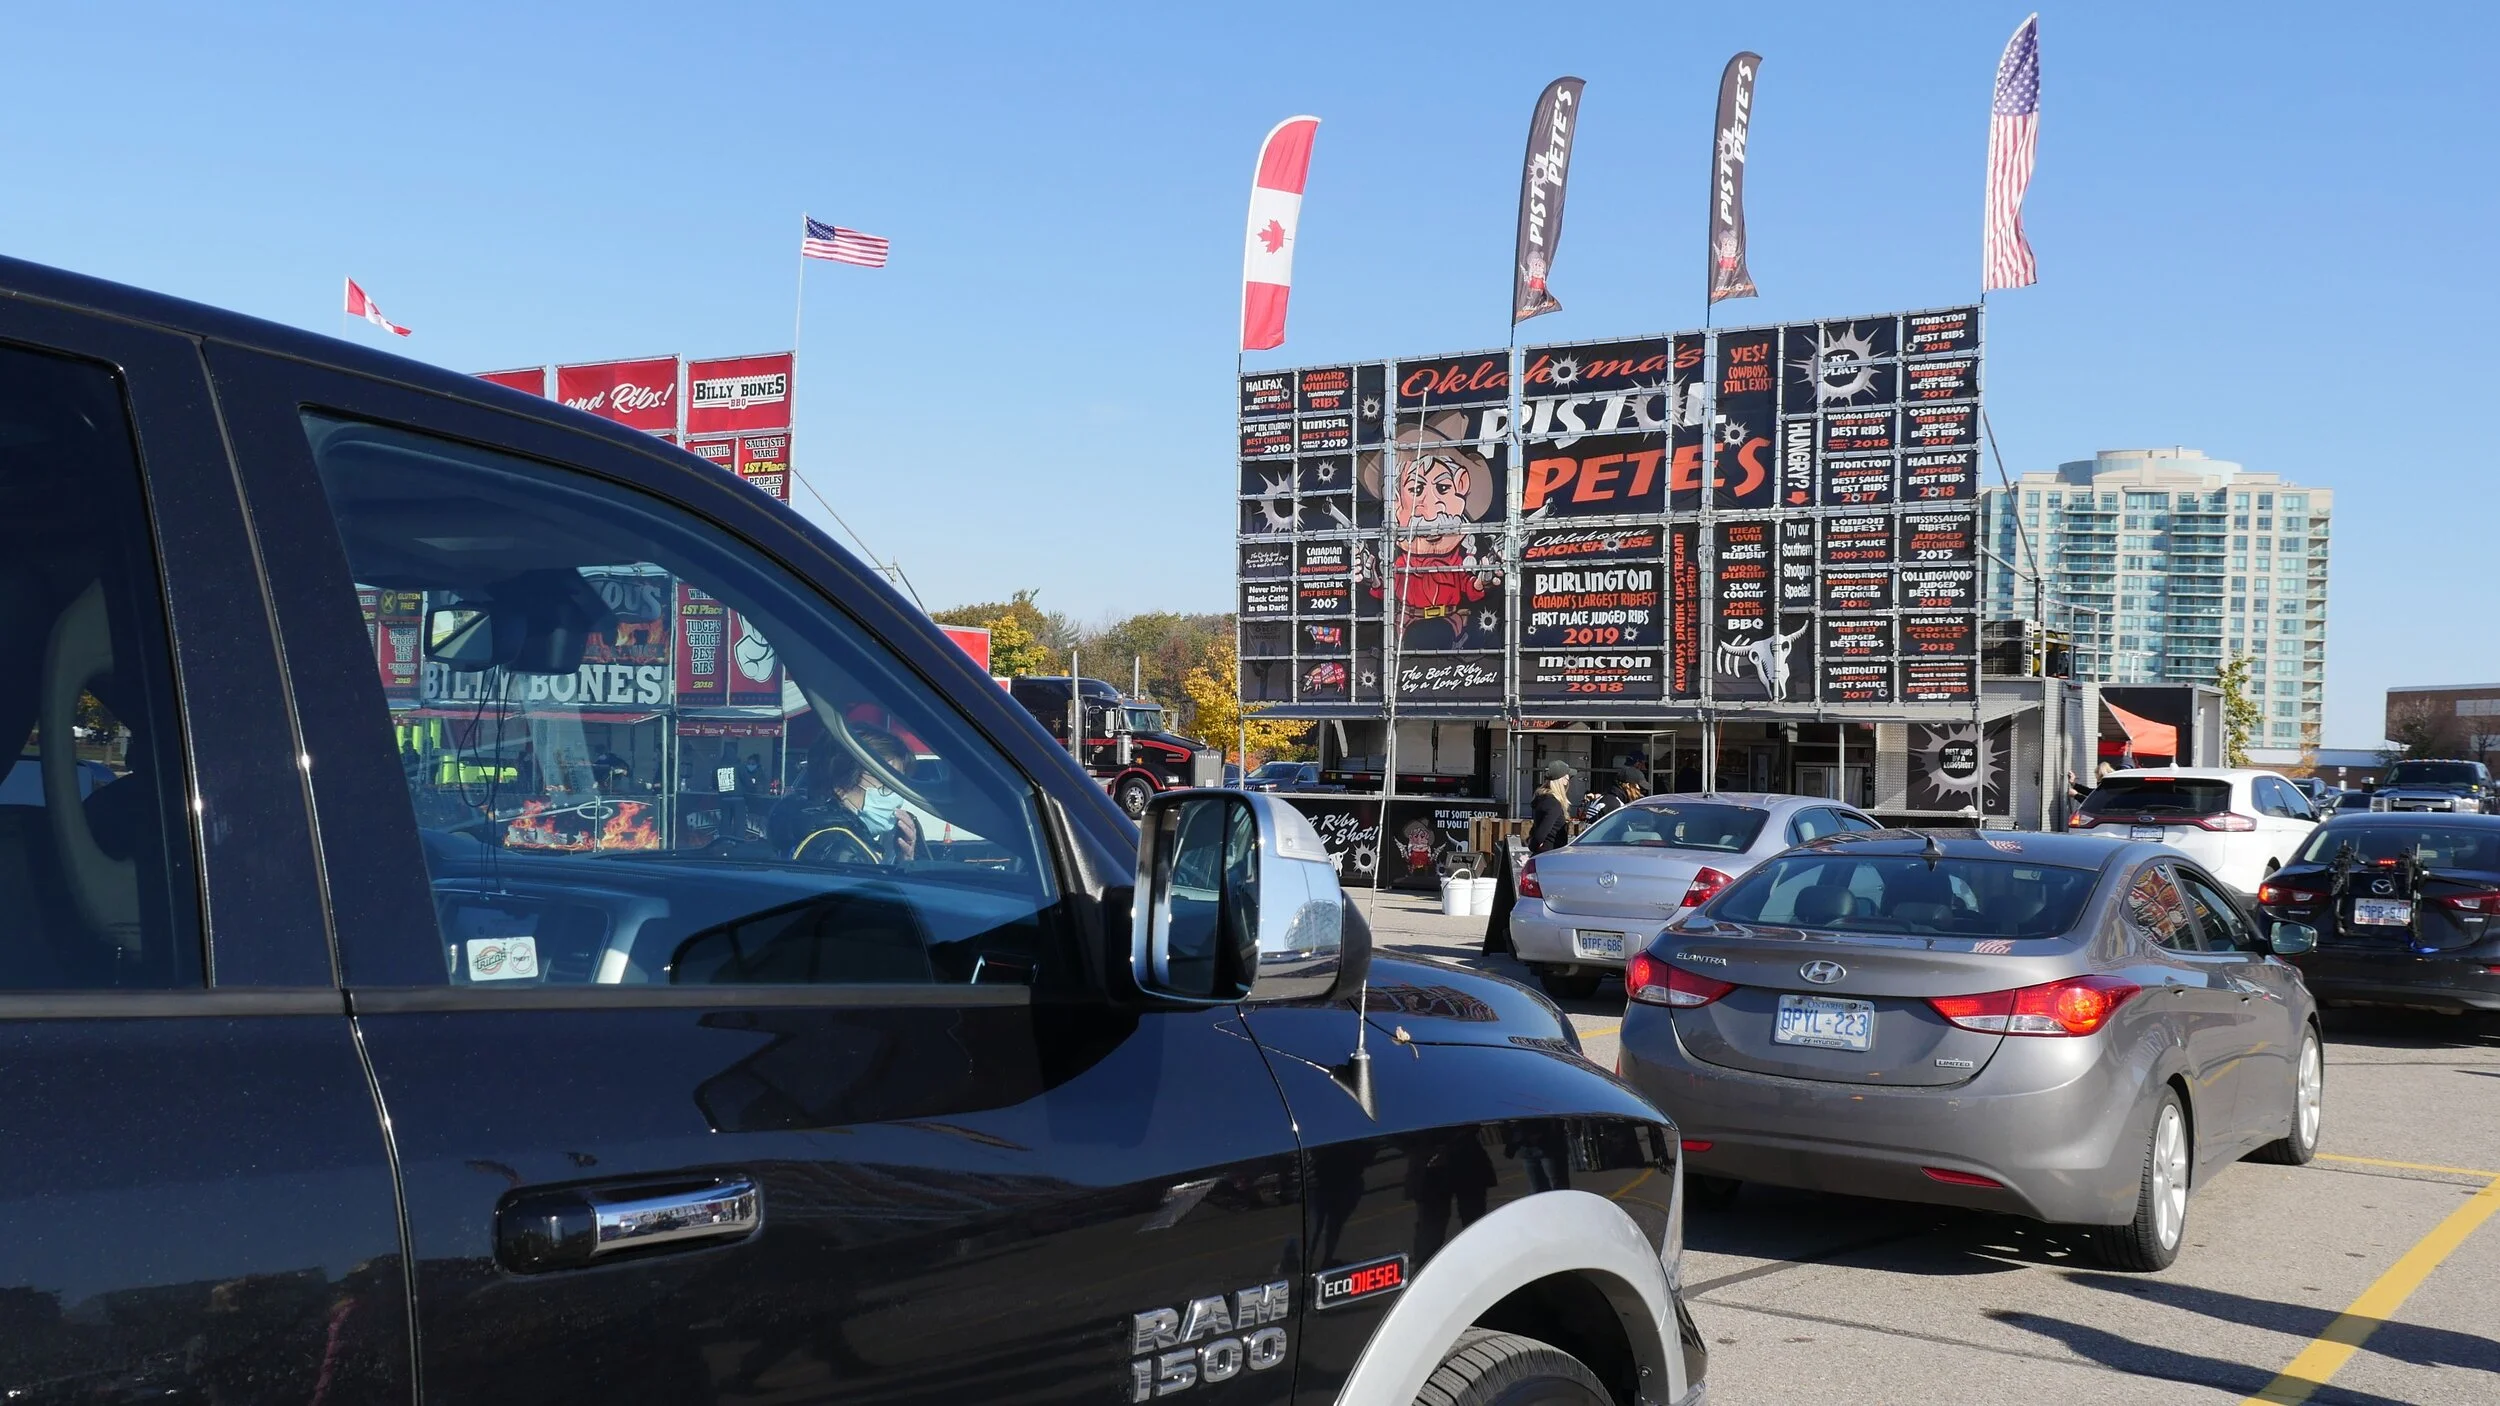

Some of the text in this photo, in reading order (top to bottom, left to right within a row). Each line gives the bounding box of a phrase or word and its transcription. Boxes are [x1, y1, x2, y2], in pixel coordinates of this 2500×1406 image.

[1734, 60, 1752, 164] PETE'S
[1548, 85, 1572, 187] PETE'S
[1716, 128, 1735, 226] PISTOL
[1528, 151, 1551, 247] PISTOL
[1913, 329, 1965, 343] BEST RIBS
[1923, 342, 1952, 351] 2018
[1730, 343, 1769, 363] YES!
[1908, 361, 1971, 371] GRAVENHURST
[1306, 371, 1345, 382] AWARD
[1728, 365, 1768, 379] COWBOYS
[695, 376, 784, 400] BILLY BONES
[1246, 378, 1283, 392] HALIFAX
[1302, 380, 1349, 391] WINNING
[1724, 378, 1773, 393] STILL EXIST
[1910, 380, 1964, 390] BEST RIBS
[610, 383, 675, 413] Ribs!
[1921, 389, 1953, 398] 2017
[731, 399, 746, 407] BBQ
[1311, 397, 1339, 408] RIBS
[1827, 411, 1891, 421] WASAGA BEACH
[1909, 406, 1970, 417] OSHAWA
[1302, 419, 1348, 430] INNISFIL
[1477, 381, 1726, 459] PISTOL
[1302, 431, 1326, 440] BEST
[1831, 425, 1886, 437] BEST RIBS
[1911, 427, 1965, 438] BEST RIBS
[746, 438, 785, 448] SAULT STE
[1322, 438, 1348, 448] 2019
[1852, 439, 1889, 448] 2018
[1922, 437, 1954, 445] 2017
[695, 446, 730, 457] INNISFIL
[754, 449, 778, 458] MARIE
[1264, 443, 1292, 454] 2019
[1787, 422, 1811, 489] HUNGRY?
[1907, 453, 1968, 467] HALIFAX
[743, 462, 787, 474] 1ST Place
[749, 476, 782, 485] PEOPLES
[1908, 473, 1966, 485] BEST RIBS
[763, 487, 780, 496] OICE
[1833, 483, 1888, 494] BEST RIBS
[1831, 517, 1884, 526] LONDON
[1906, 515, 1971, 524] MISSISSAUGA
[1831, 524, 1885, 533] RIBFEST
[1918, 523, 1958, 531] RIBFEST
[1533, 528, 1649, 547] Oklahoma
[1524, 536, 1655, 559] SMOKEHOUSE
[1731, 544, 1761, 552] SPICE
[1828, 539, 1886, 548] BEST SAUCE
[1306, 547, 1342, 556] CANADIAN
[1782, 543, 1813, 557] Southern
[1830, 550, 1886, 560] 2009-2010
[1916, 549, 1953, 560] 2015
[1307, 555, 1341, 565] NATIONAL
[1784, 563, 1812, 580] Shotgun
[1901, 570, 1973, 581] COLLINGWOOD
[1536, 568, 1652, 595] BURLINGTON
[1730, 582, 1760, 591] SLOW
[1909, 588, 1965, 598] BEST RIBS
[1310, 597, 1338, 609] 2005
[1532, 591, 1658, 609] CANADA'S LARGEST RIBFEST
[1729, 601, 1760, 609] PORK
[682, 605, 699, 614] 1ST
[1674, 533, 1686, 692] ALWAYS DRINK UPSTREAM
[1687, 600, 1697, 626] THE
[1532, 609, 1649, 627] FIRST PLACE JUDGED RIBS
[686, 620, 721, 635] JUDGE'S
[1727, 618, 1764, 630] BBQ
[689, 634, 720, 646] CHOICE
[1562, 627, 1619, 644] 2019
[1687, 628, 1697, 664] FROM
[1830, 640, 1858, 648] BEST
[1919, 643, 1956, 651] 2018
[693, 647, 715, 660] BEST
[693, 662, 713, 673] RIBS
[1401, 663, 1482, 682] The Best Ribs
[528, 665, 663, 705] BONES
[1432, 678, 1461, 690] Long
[1465, 672, 1497, 686] Shot!
[1855, 681, 1887, 689] SAUCE
[1565, 682, 1624, 692] 2018
[1843, 691, 1873, 699] 2017
[1435, 810, 1450, 818] PUT
[1451, 811, 1472, 819] SOME
[1321, 812, 1359, 832] Ribs
[1335, 826, 1380, 845] Shot!
[1676, 952, 1727, 966] ELANTRA
[1807, 1001, 1844, 1010] ONTARIO
[1781, 1007, 1868, 1037] BPYL 223
[1325, 1263, 1402, 1298] ECODIESEL
[1132, 1279, 1289, 1356] RAM
[1131, 1327, 1288, 1404] 1500
